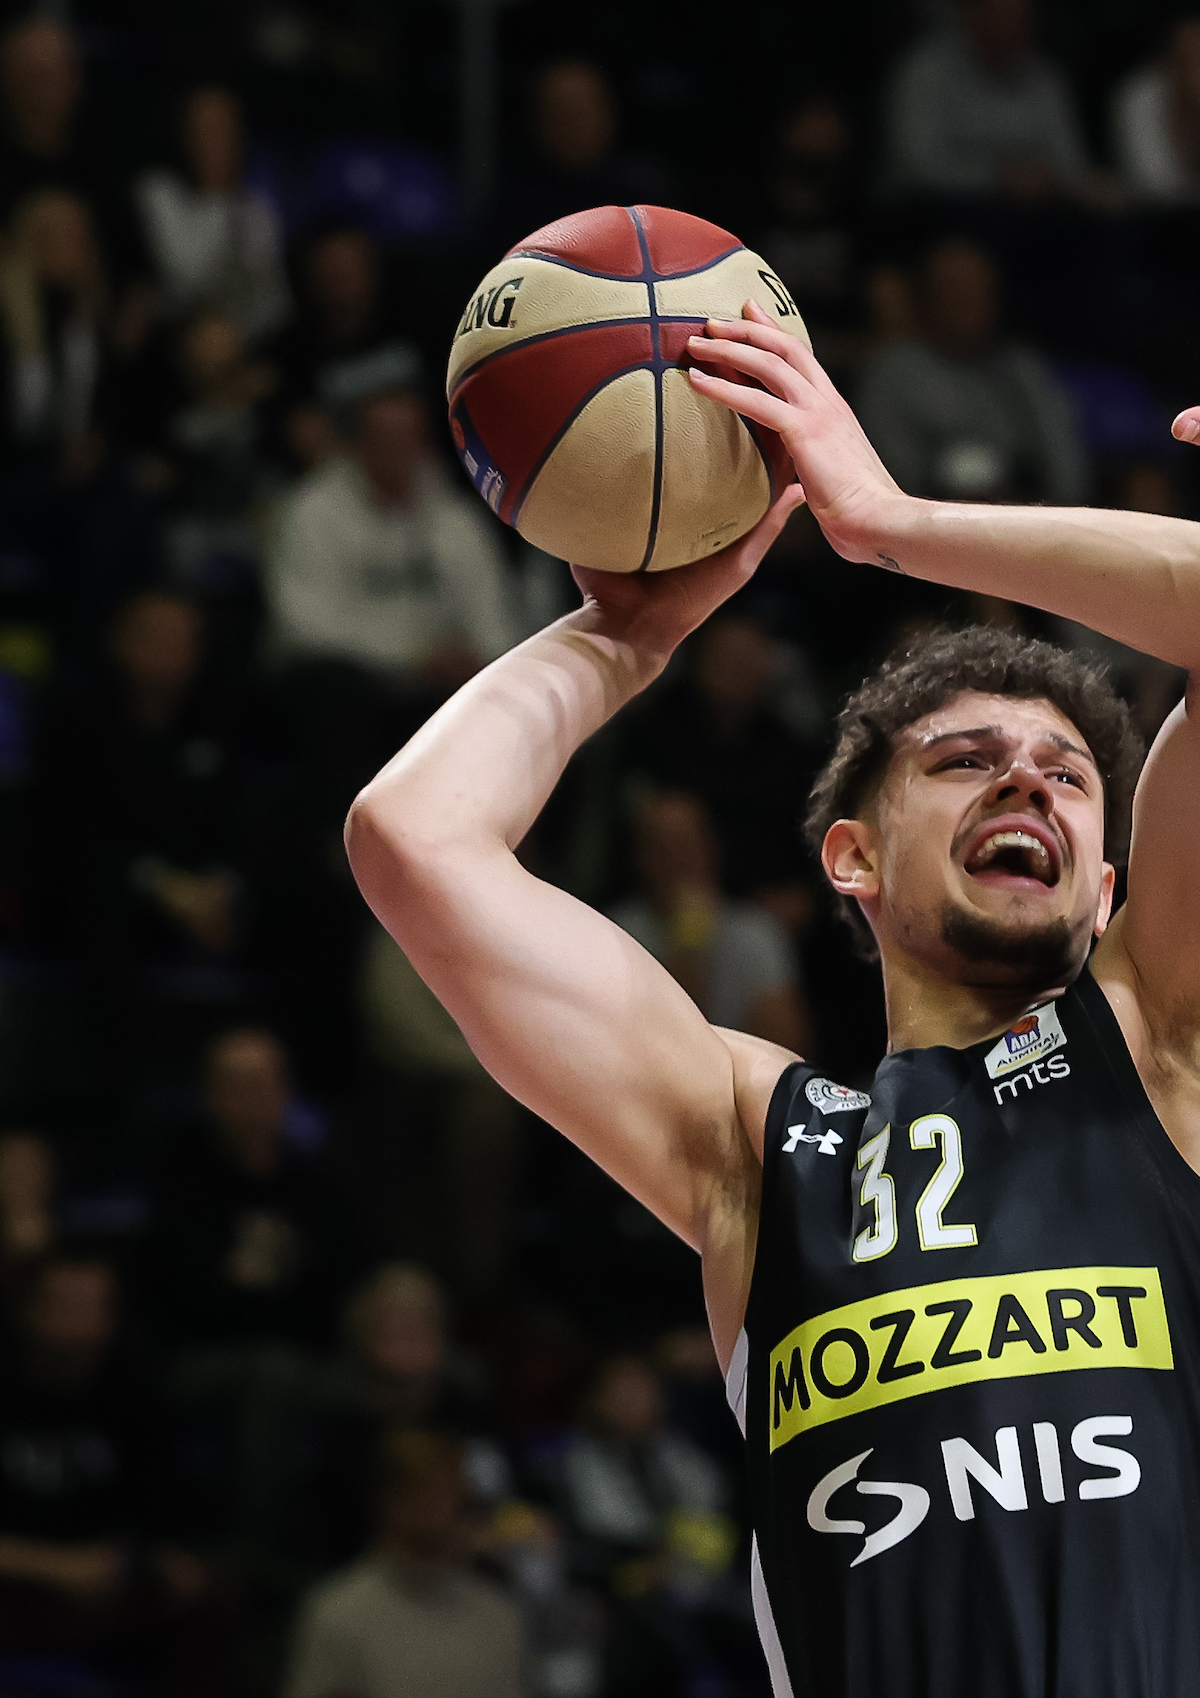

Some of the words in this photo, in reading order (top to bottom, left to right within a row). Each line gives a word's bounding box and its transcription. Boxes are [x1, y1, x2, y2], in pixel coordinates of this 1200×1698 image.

[993, 1054, 1071, 1106] mts
[852, 1113, 979, 1264] 32
[773, 1286, 1148, 1430] MOZZART
[940, 1415, 1142, 1522] NIS
